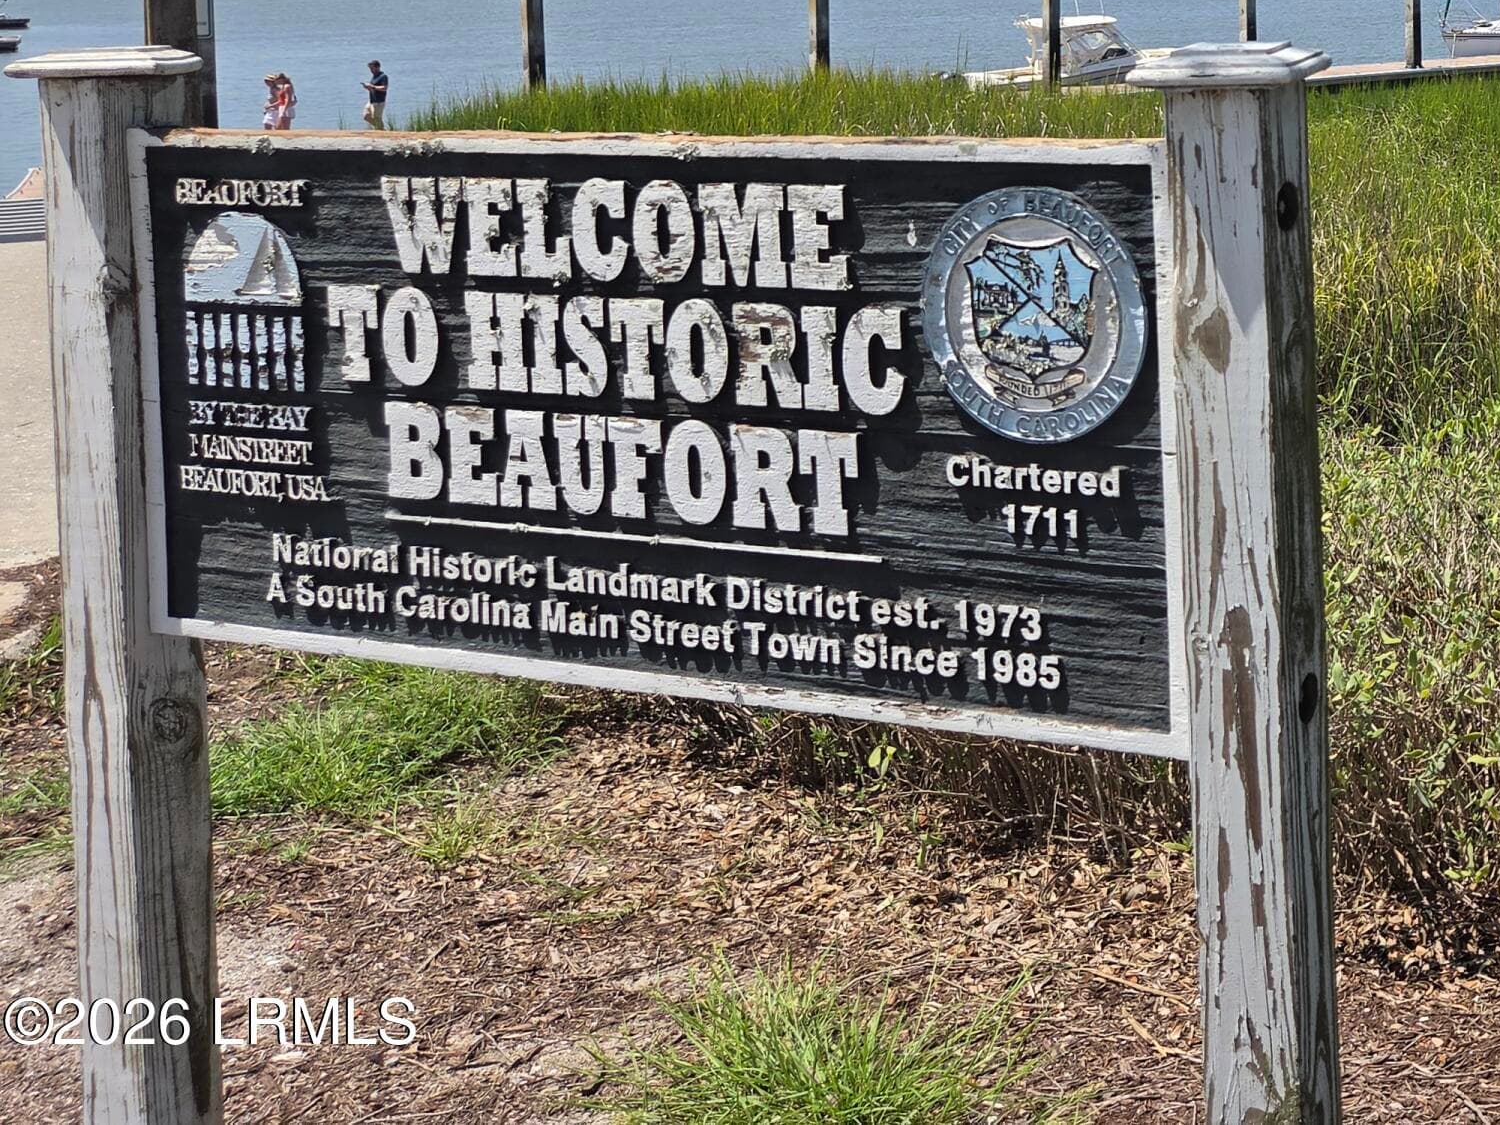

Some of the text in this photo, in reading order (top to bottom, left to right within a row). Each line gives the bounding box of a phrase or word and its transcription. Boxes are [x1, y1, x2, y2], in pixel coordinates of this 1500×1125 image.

[176, 177, 310, 207] BEAUFORT
[381, 176, 853, 291] WELCOME
[943, 210, 982, 255] CITY
[1023, 193, 1129, 264] BEAUFORT
[328, 284, 905, 416] TO HISTORIC
[1016, 375, 1133, 438] CAROLINA
[189, 433, 314, 465] MAINSTREET
[384, 401, 863, 536] BEAUFORT
[946, 455, 1120, 498] Chartered
[180, 465, 332, 502] BEAUFORT, USA
[1001, 503, 1078, 539] 1711
[272, 533, 1042, 641] National Historic Landmark District est. 1973
[266, 573, 1062, 690] A South Carolina Main Street Town Since 1985
